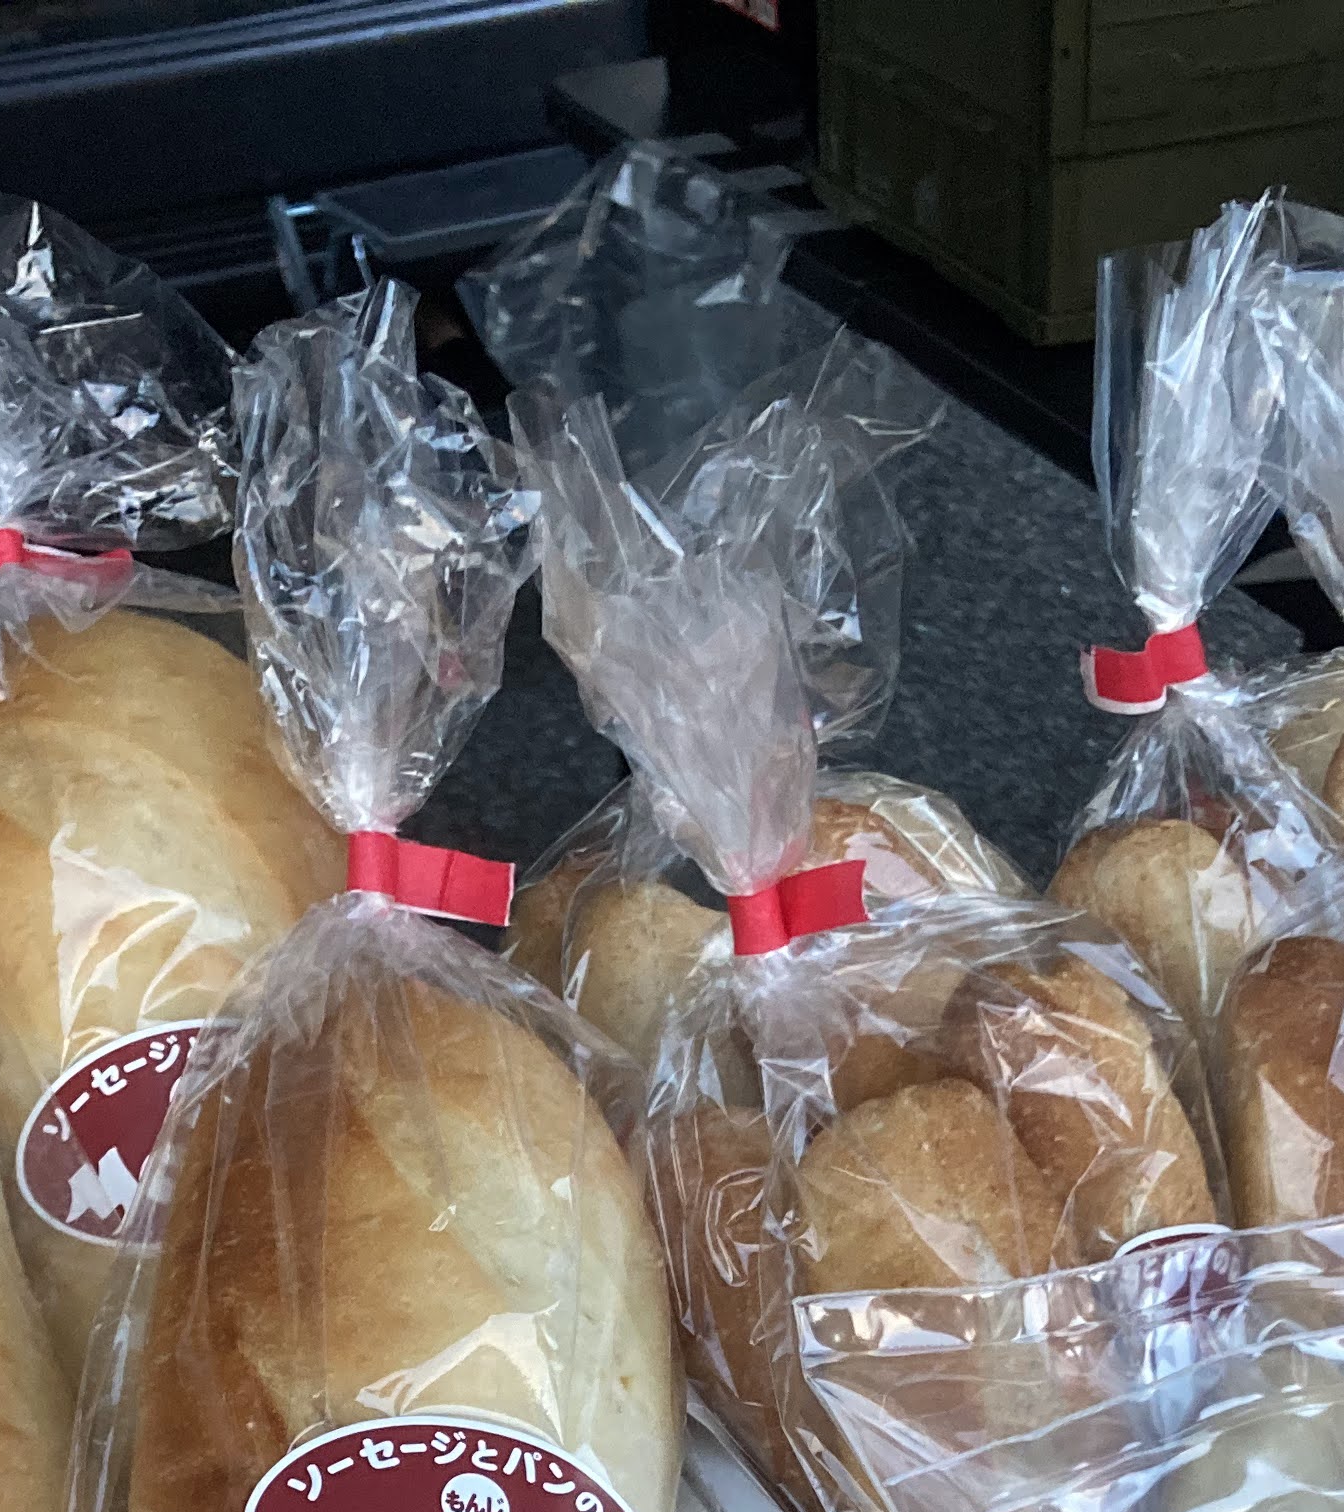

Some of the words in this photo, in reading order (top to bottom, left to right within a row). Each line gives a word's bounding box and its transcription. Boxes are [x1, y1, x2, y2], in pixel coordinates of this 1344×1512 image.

[43, 1035, 197, 1141] ソーセージ
